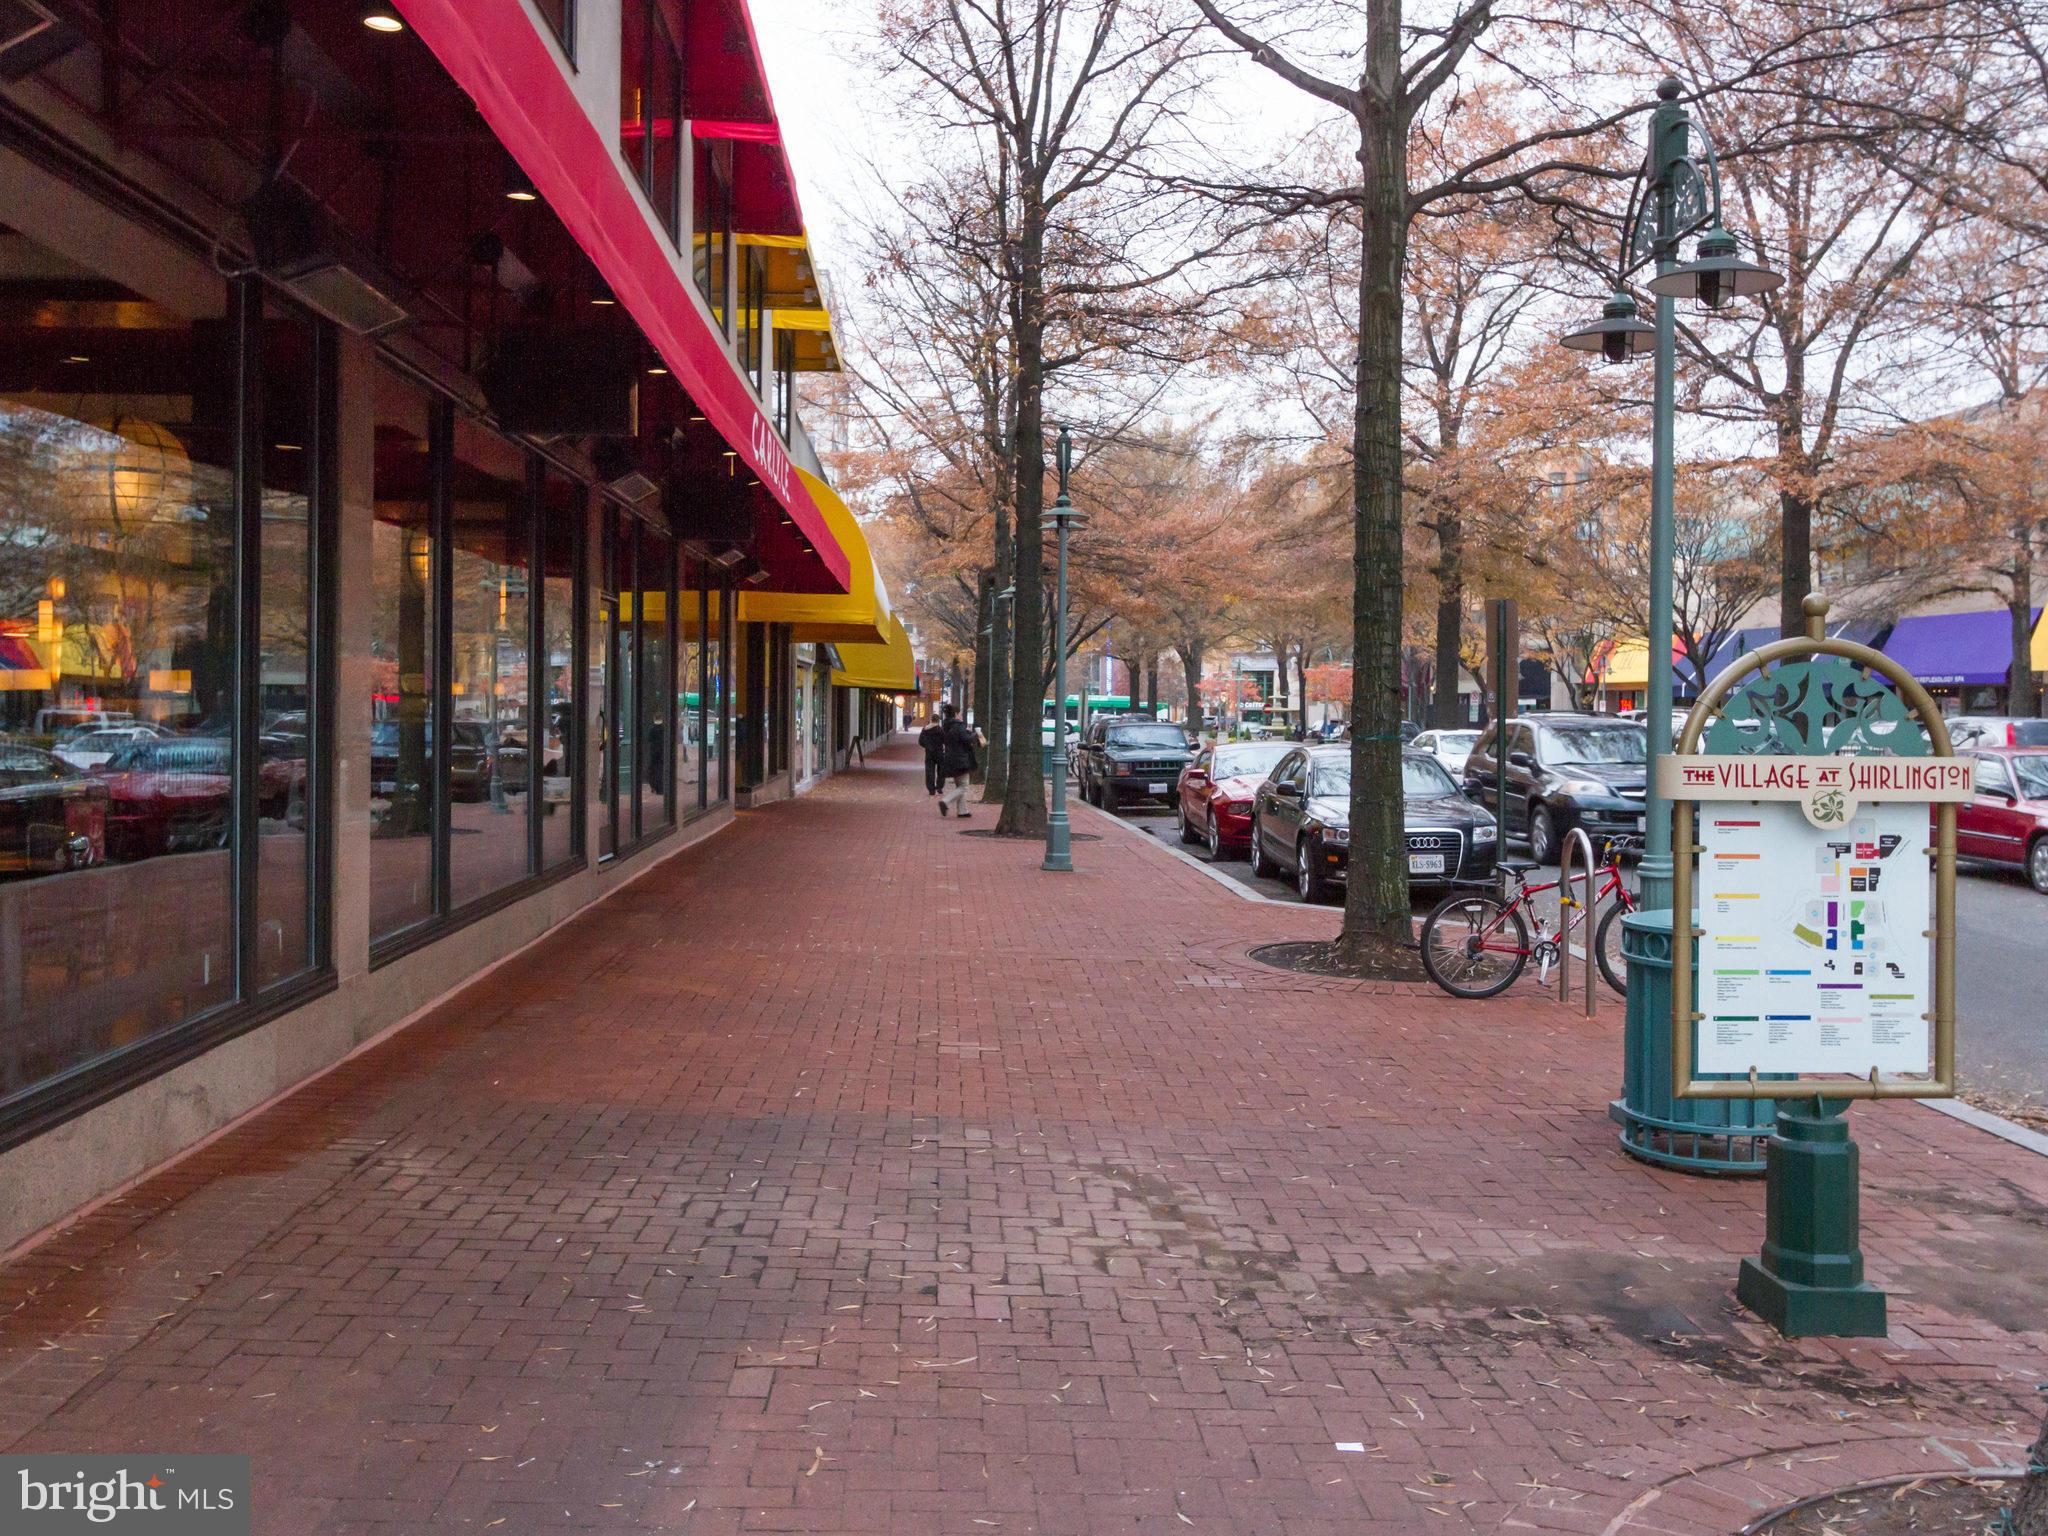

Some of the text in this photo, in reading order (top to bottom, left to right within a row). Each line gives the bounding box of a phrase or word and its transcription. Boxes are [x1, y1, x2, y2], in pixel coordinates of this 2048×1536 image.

[752, 412, 790, 503] CARLYLE
[1683, 761, 1970, 792] THE VILLAGE AT SHIRLINGTON
